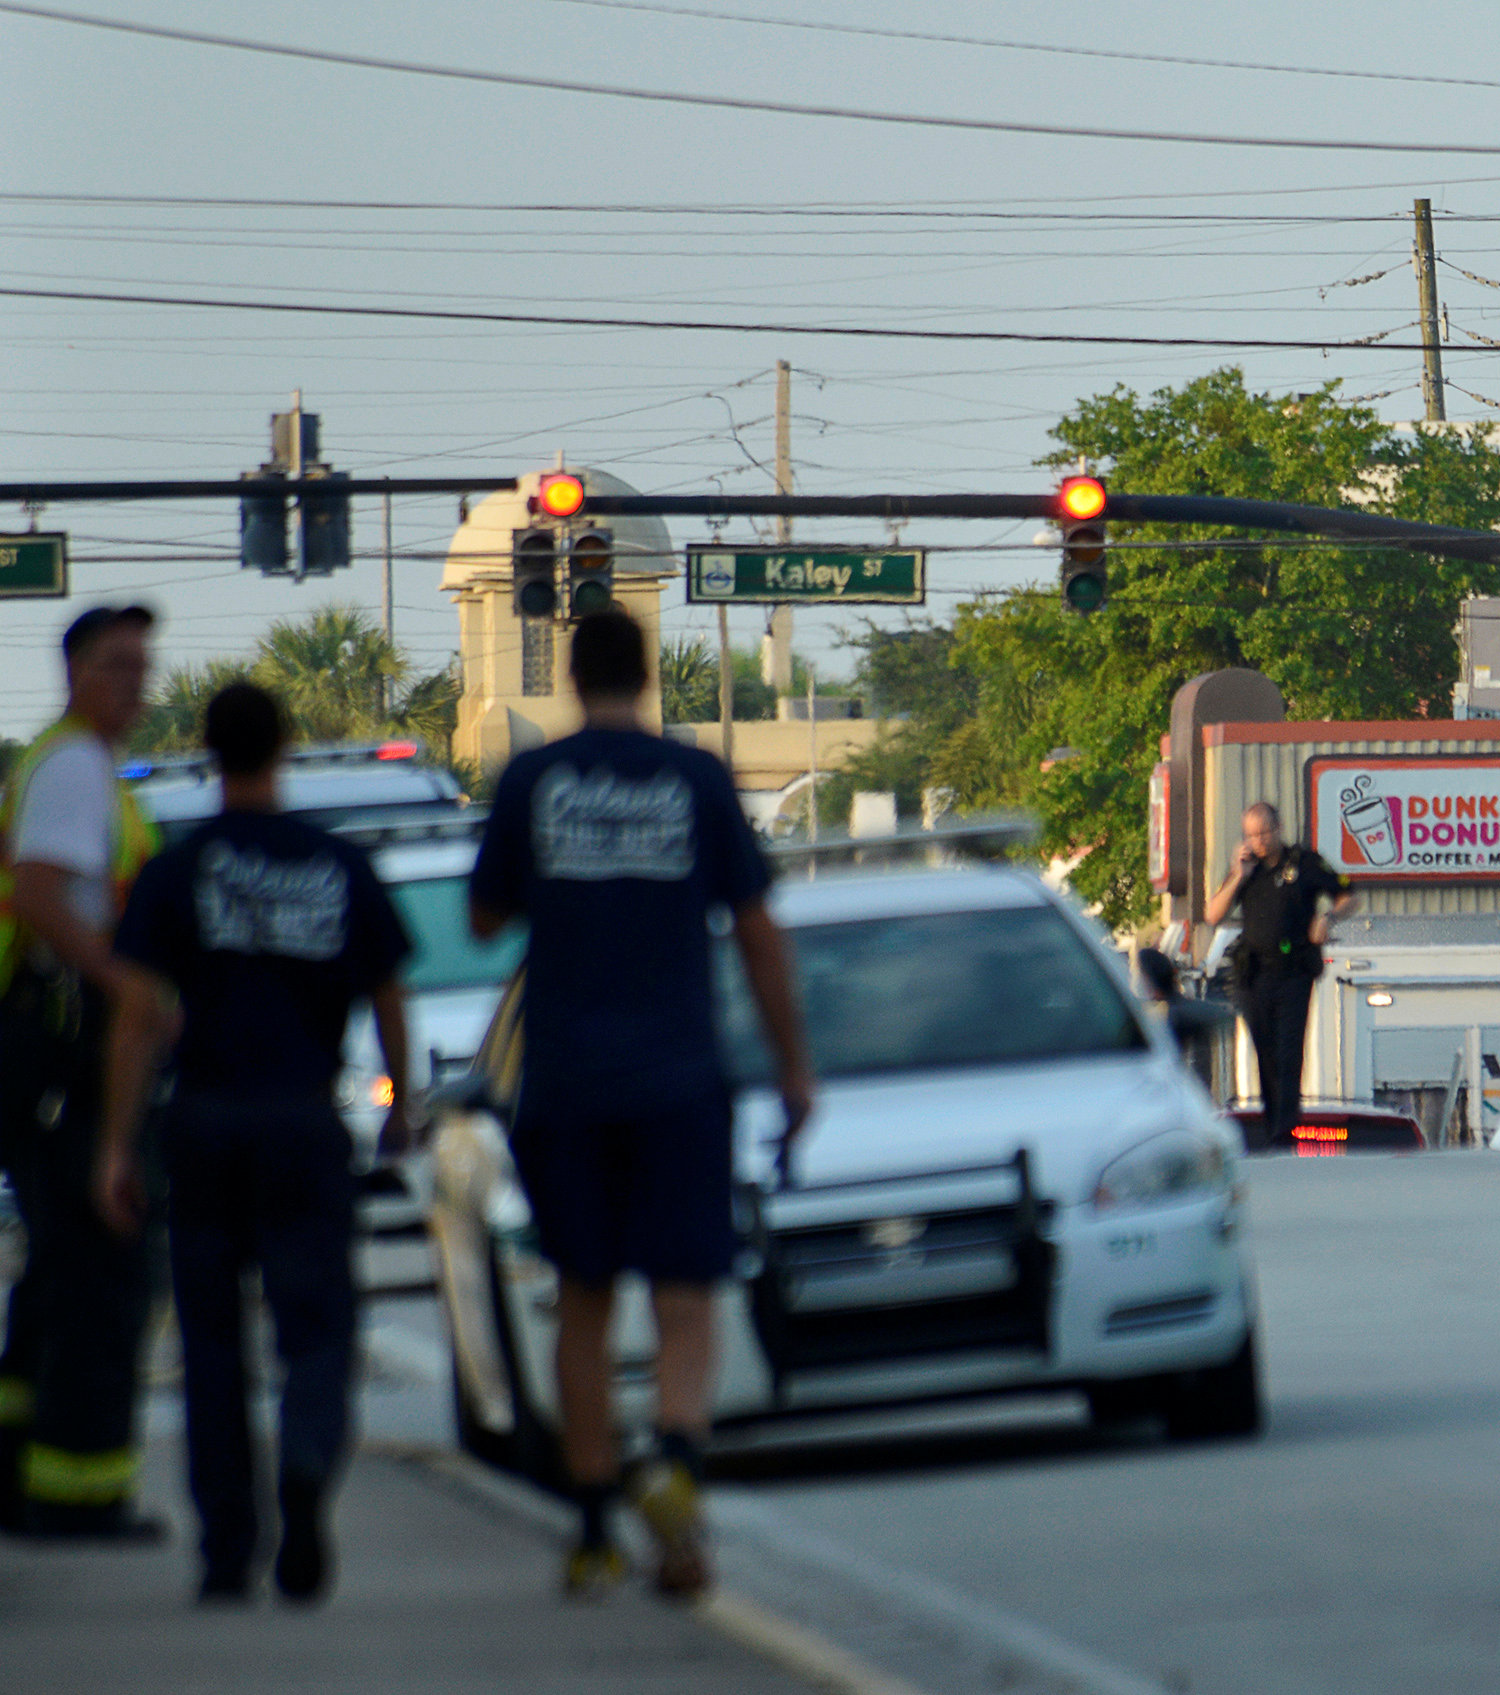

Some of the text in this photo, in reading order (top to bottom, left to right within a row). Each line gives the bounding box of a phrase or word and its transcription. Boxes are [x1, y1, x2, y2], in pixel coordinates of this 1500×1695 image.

[764, 557, 885, 595] Kaley ST
[1408, 852, 1472, 865] COFFEE
